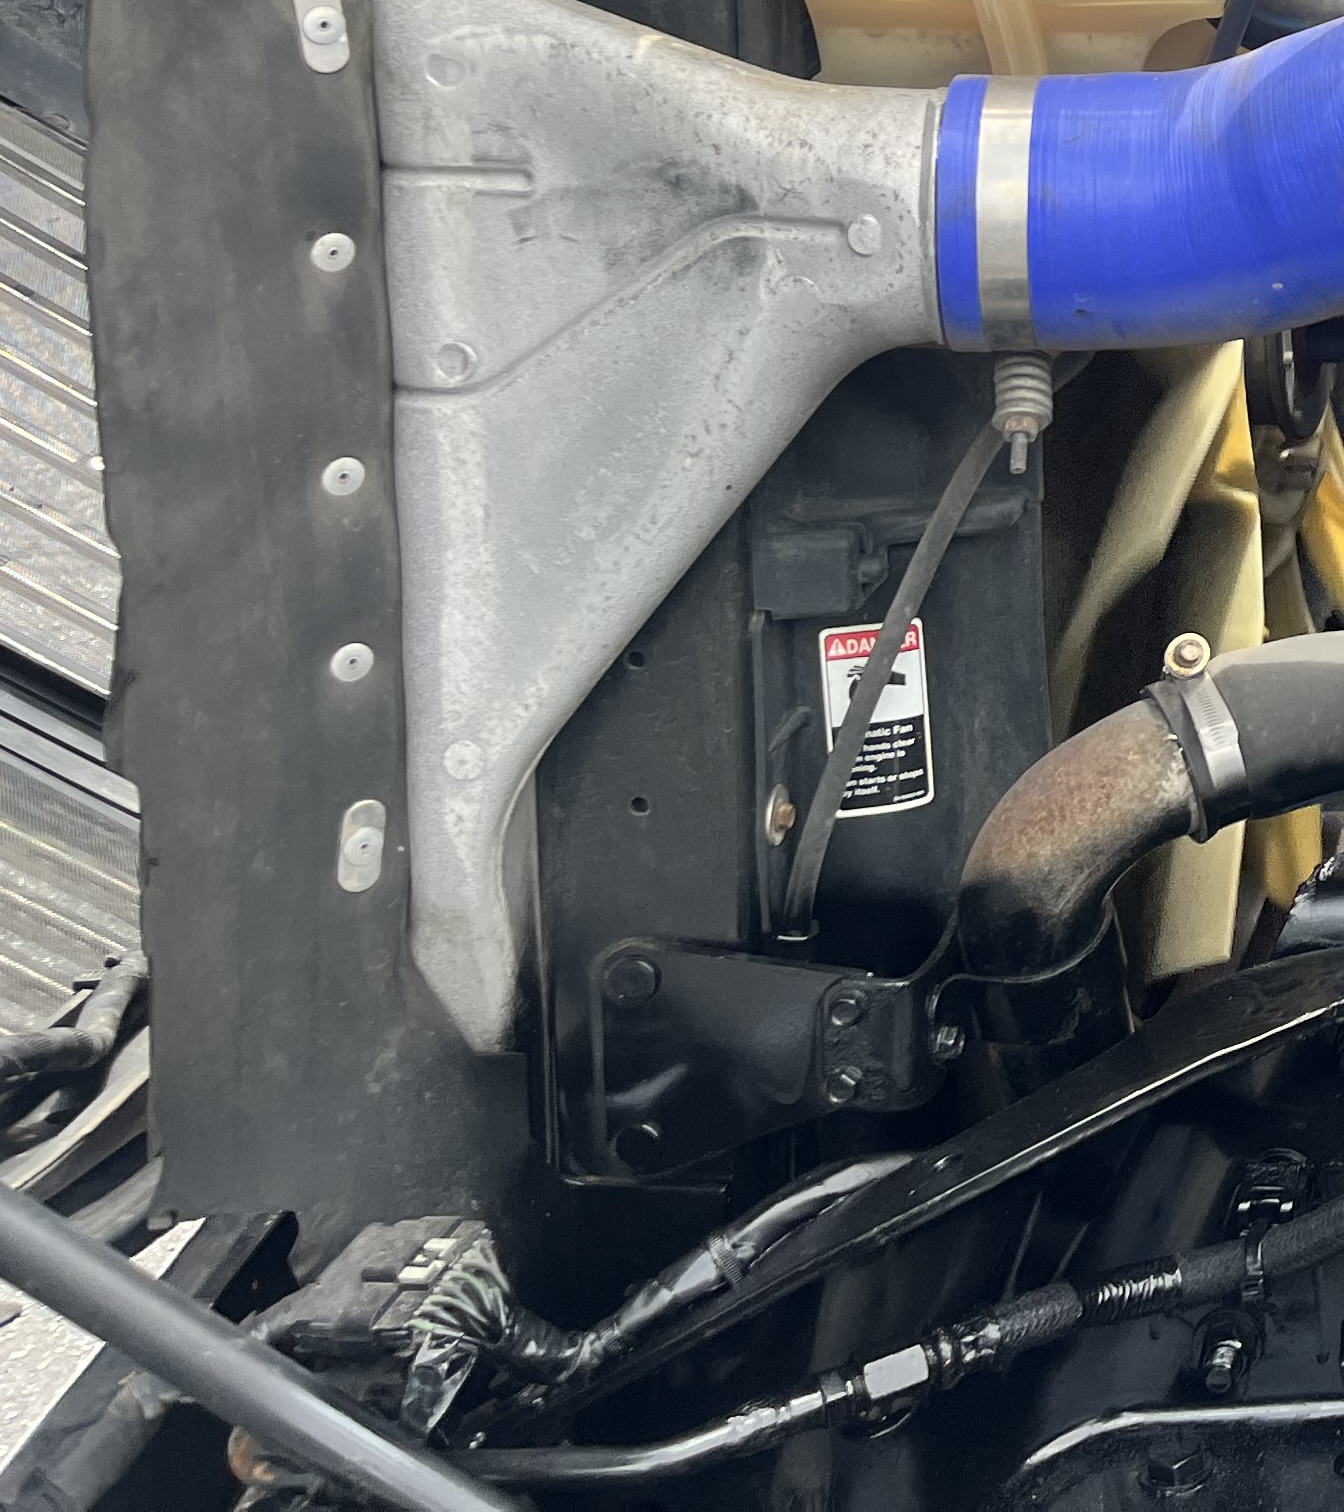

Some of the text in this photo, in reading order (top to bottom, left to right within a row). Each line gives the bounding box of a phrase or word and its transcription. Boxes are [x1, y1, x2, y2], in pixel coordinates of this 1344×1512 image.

[845, 630, 918, 656] DAR
[892, 723, 914, 735] Fan
[892, 737, 916, 749] clear
